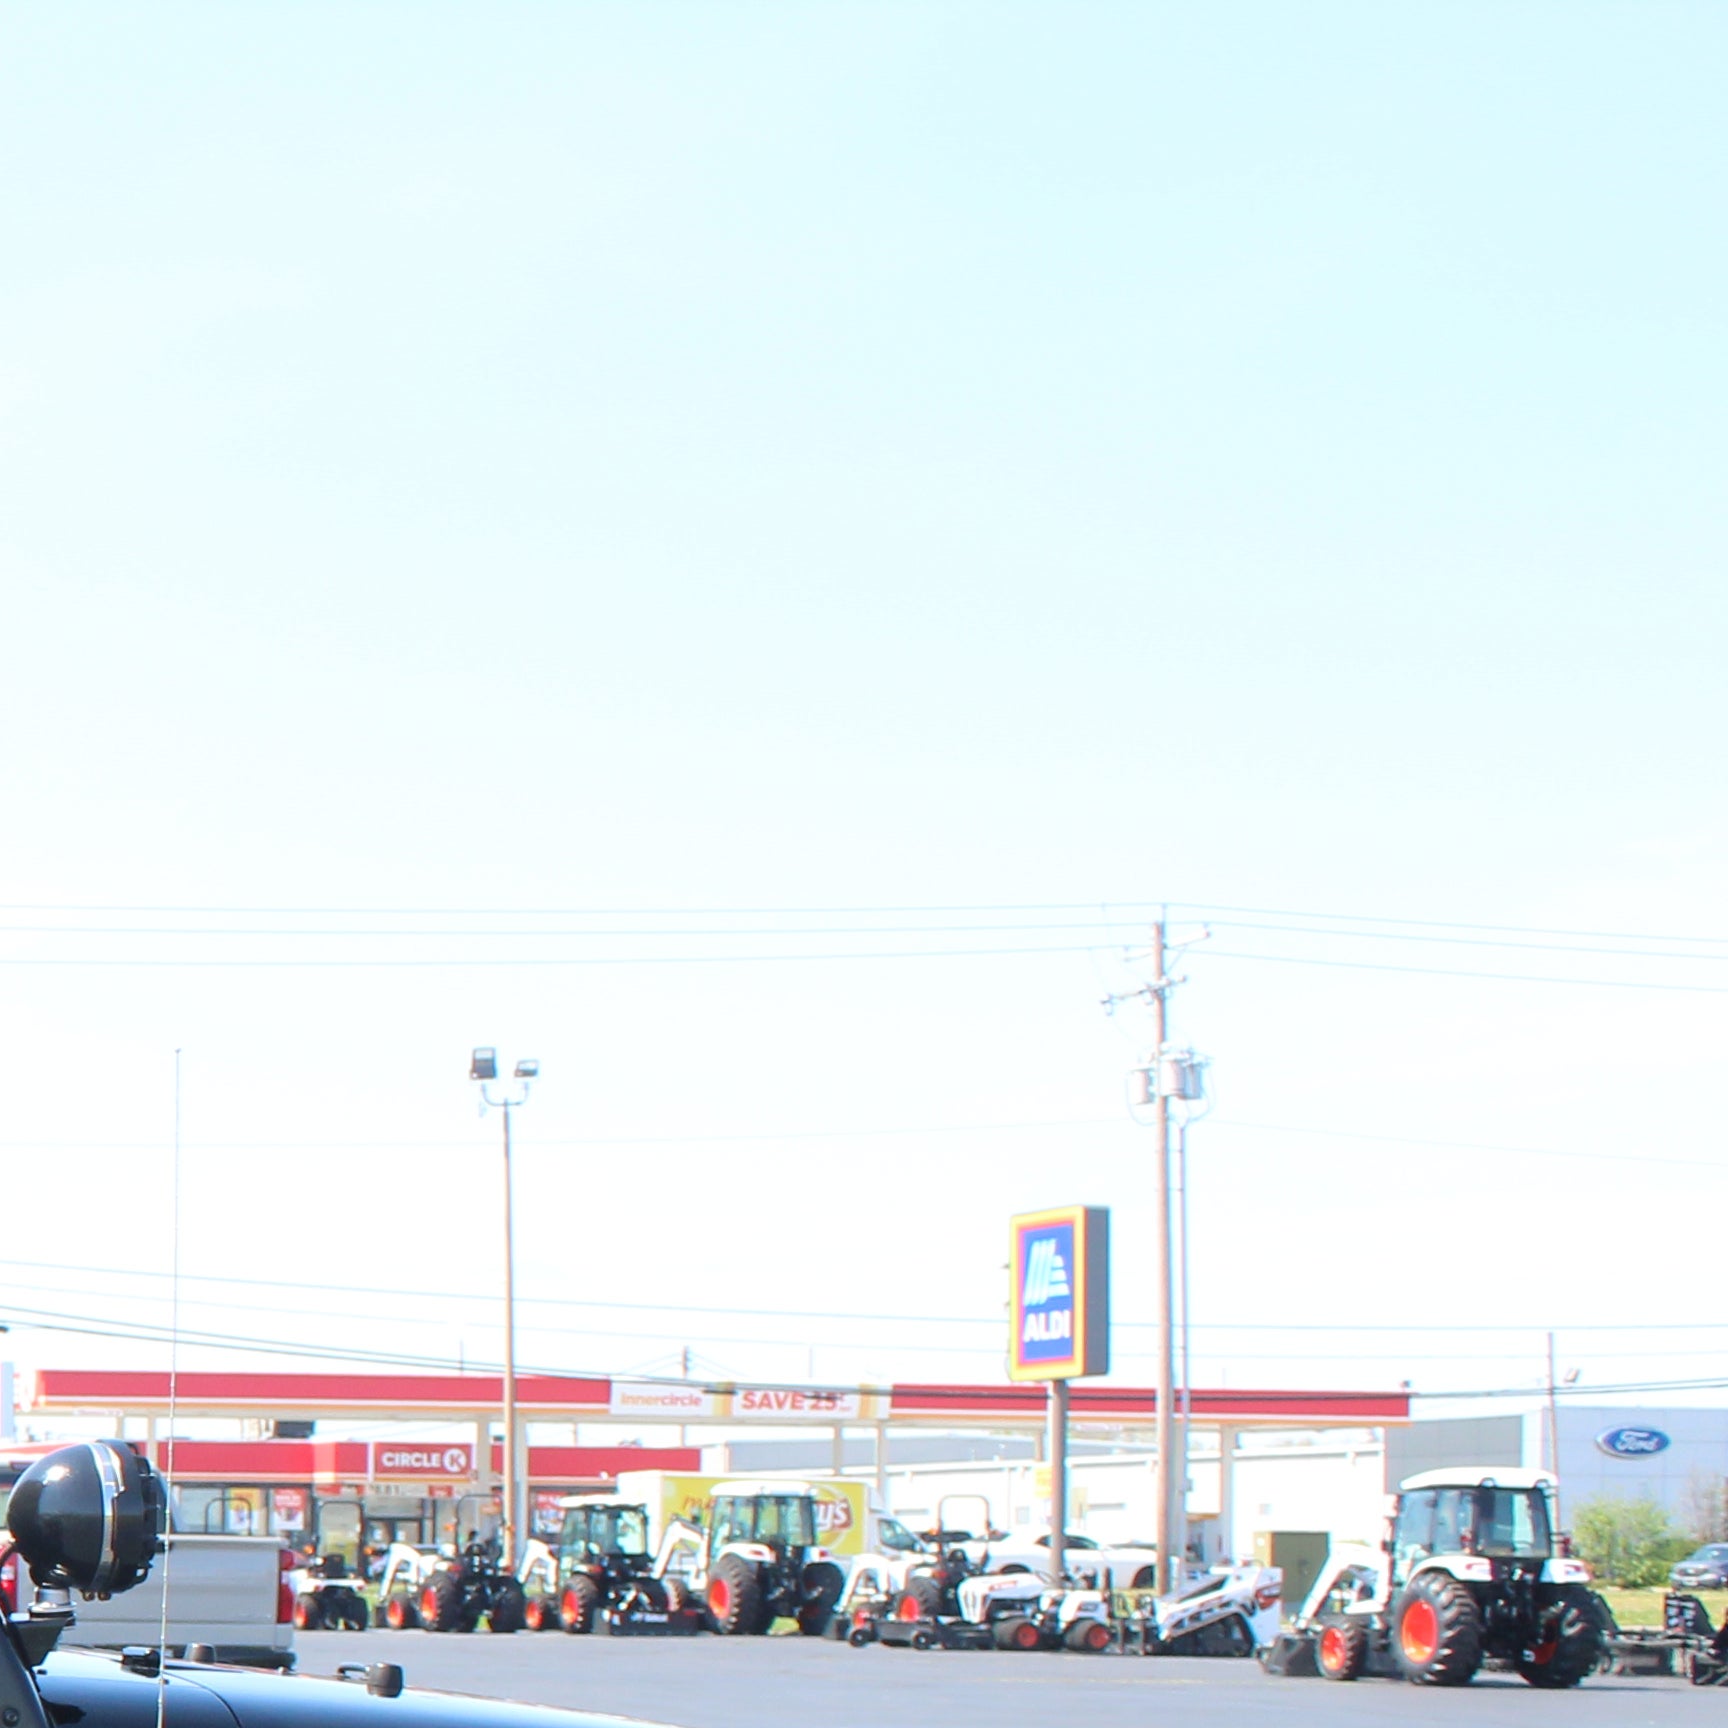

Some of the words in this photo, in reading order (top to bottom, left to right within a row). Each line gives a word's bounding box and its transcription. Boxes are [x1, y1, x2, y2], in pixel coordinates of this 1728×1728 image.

[1022, 1309, 1071, 1342] ALDI
[741, 1390, 804, 1410] SAVE
[1610, 1429, 1662, 1453] Ford
[381, 1452, 442, 1468] CIRCLE
[443, 1448, 466, 1473] K
